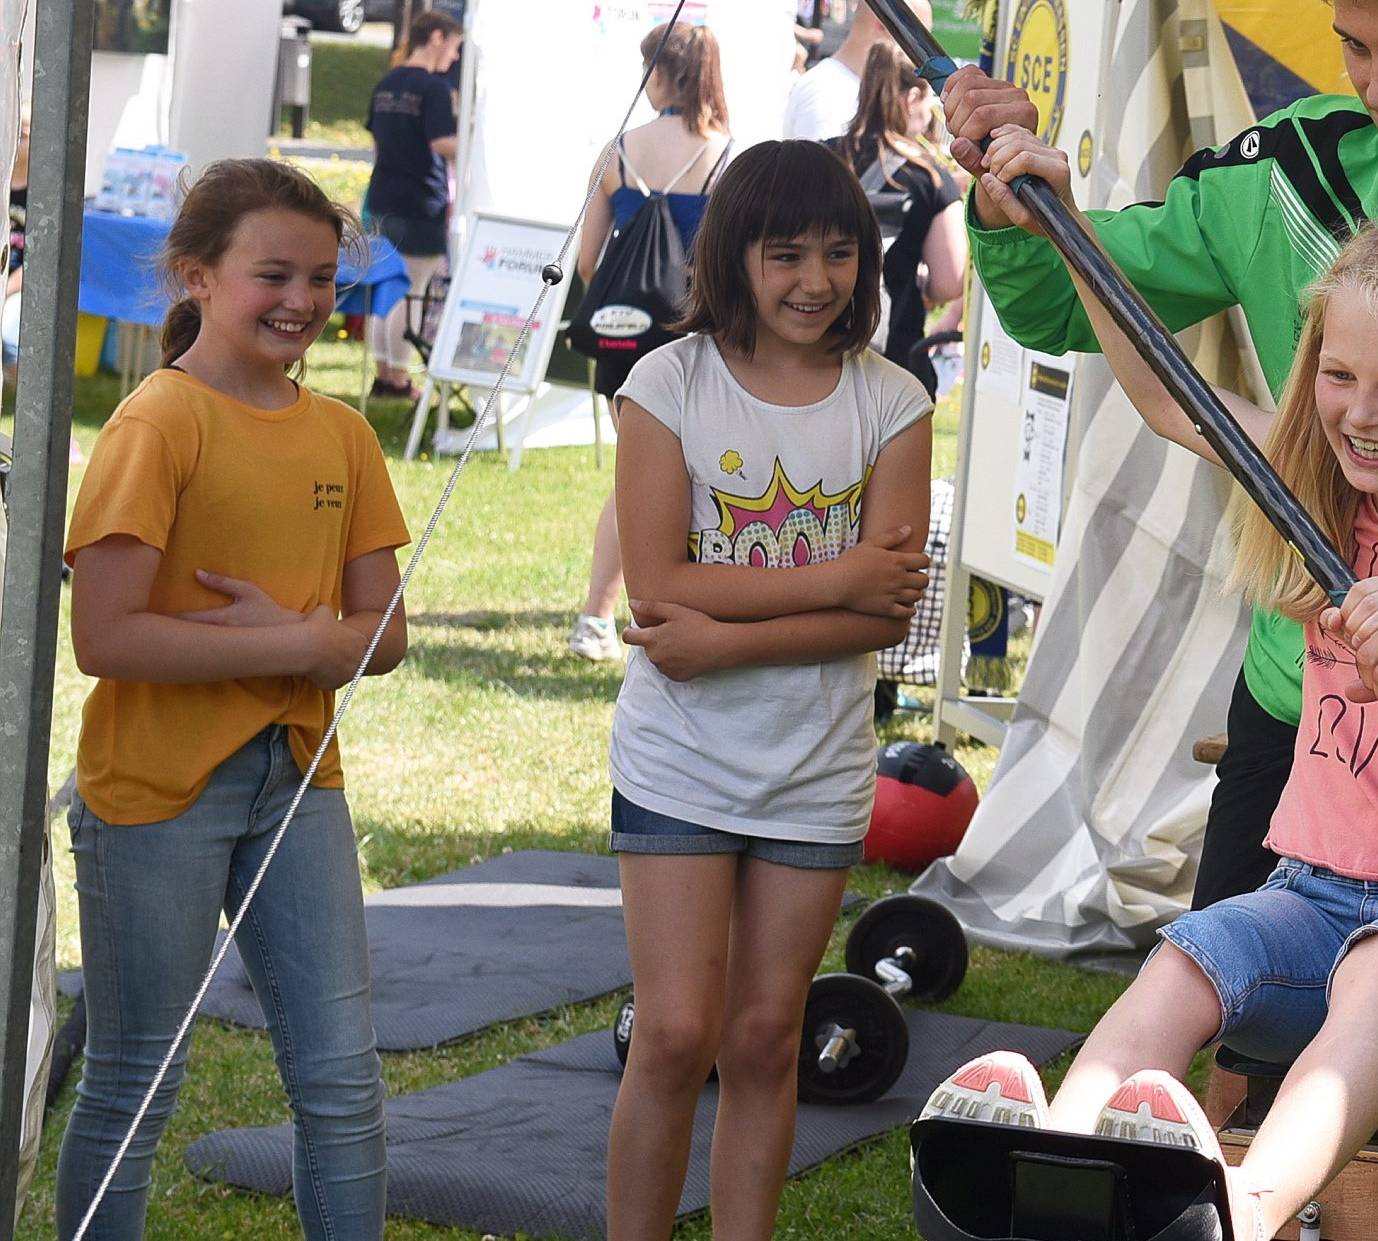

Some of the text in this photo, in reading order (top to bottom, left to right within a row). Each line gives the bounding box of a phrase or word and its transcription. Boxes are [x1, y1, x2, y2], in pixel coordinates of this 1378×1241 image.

[1021, 53, 1052, 93] SCE
[313, 480, 324, 495] je
[313, 496, 325, 510] je
